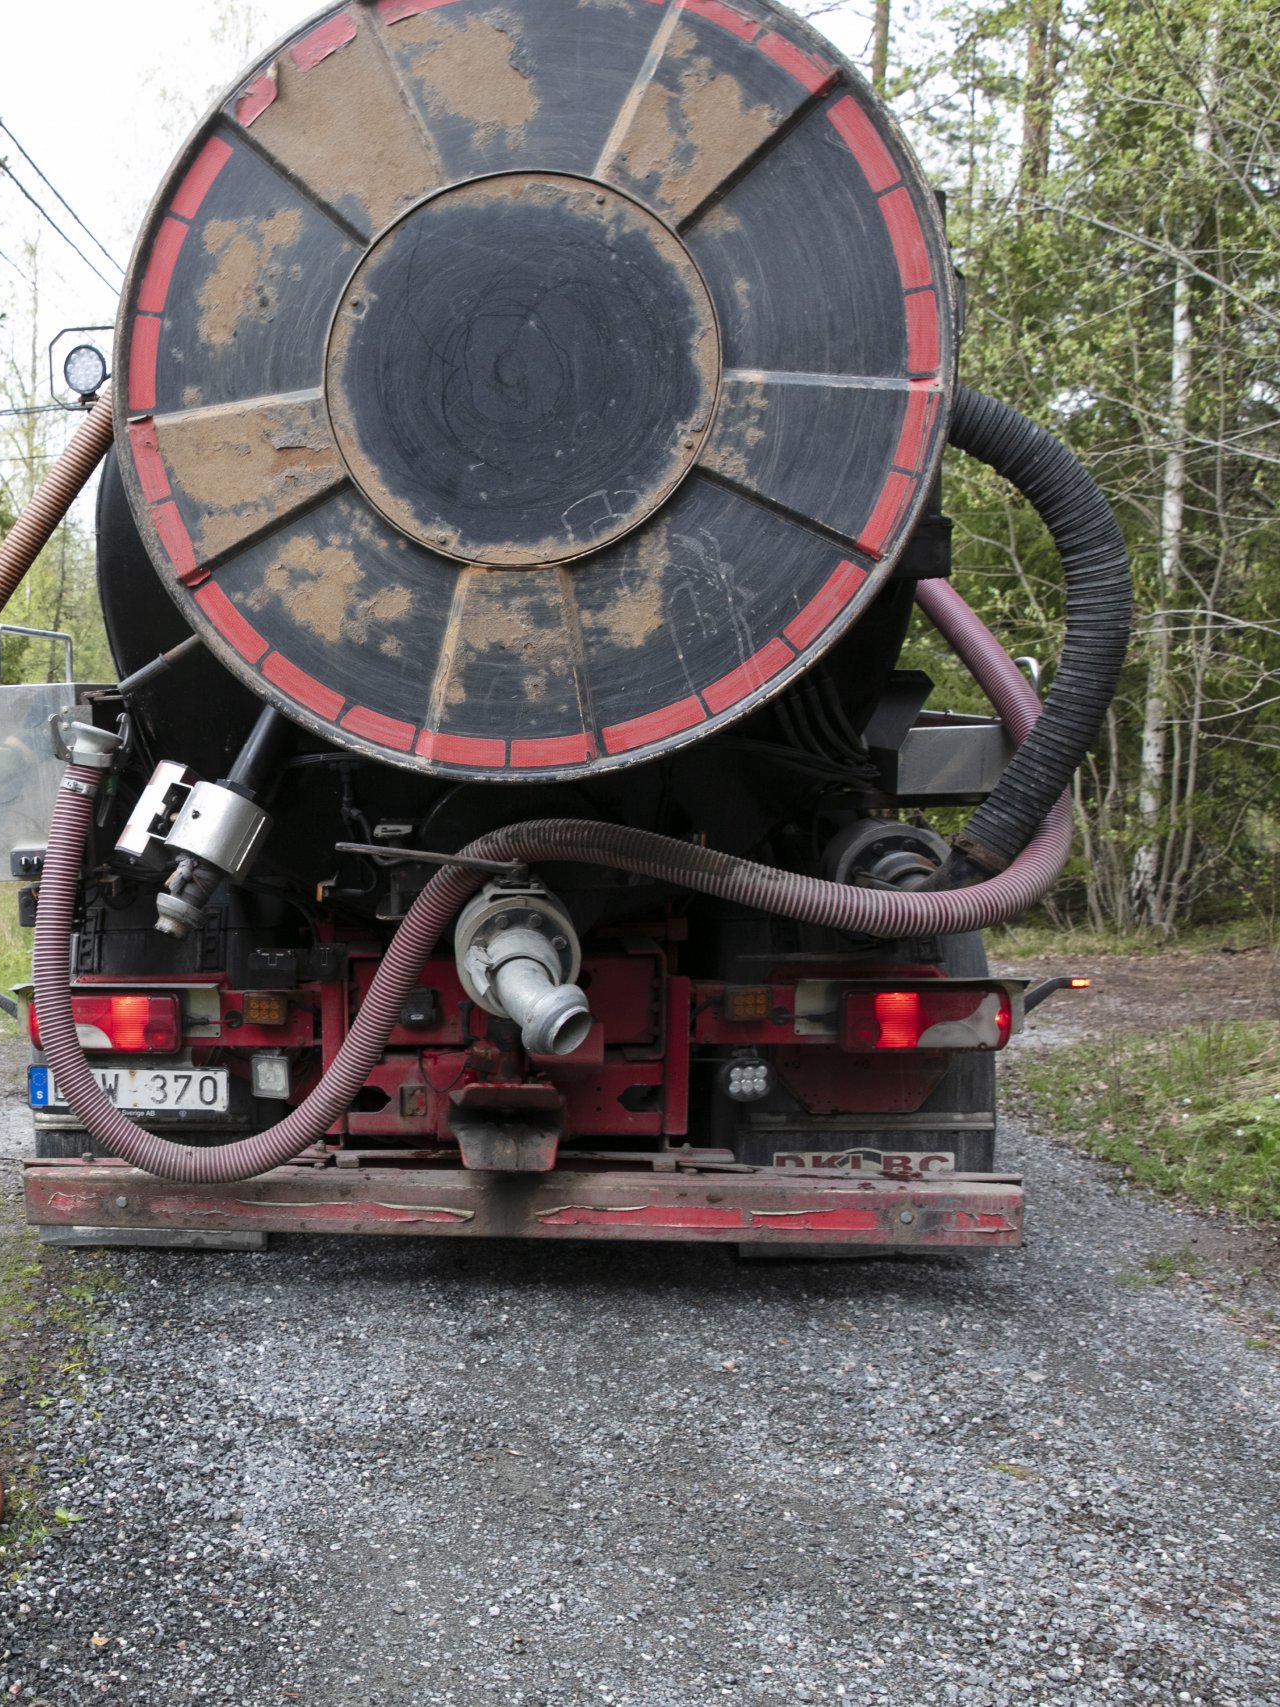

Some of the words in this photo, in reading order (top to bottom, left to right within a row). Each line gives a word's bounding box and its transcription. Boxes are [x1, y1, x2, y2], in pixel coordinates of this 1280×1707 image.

[150, 1074, 218, 1106] 370
[36, 1091, 44, 1099] S
[121, 1110, 145, 1118] Sverige
